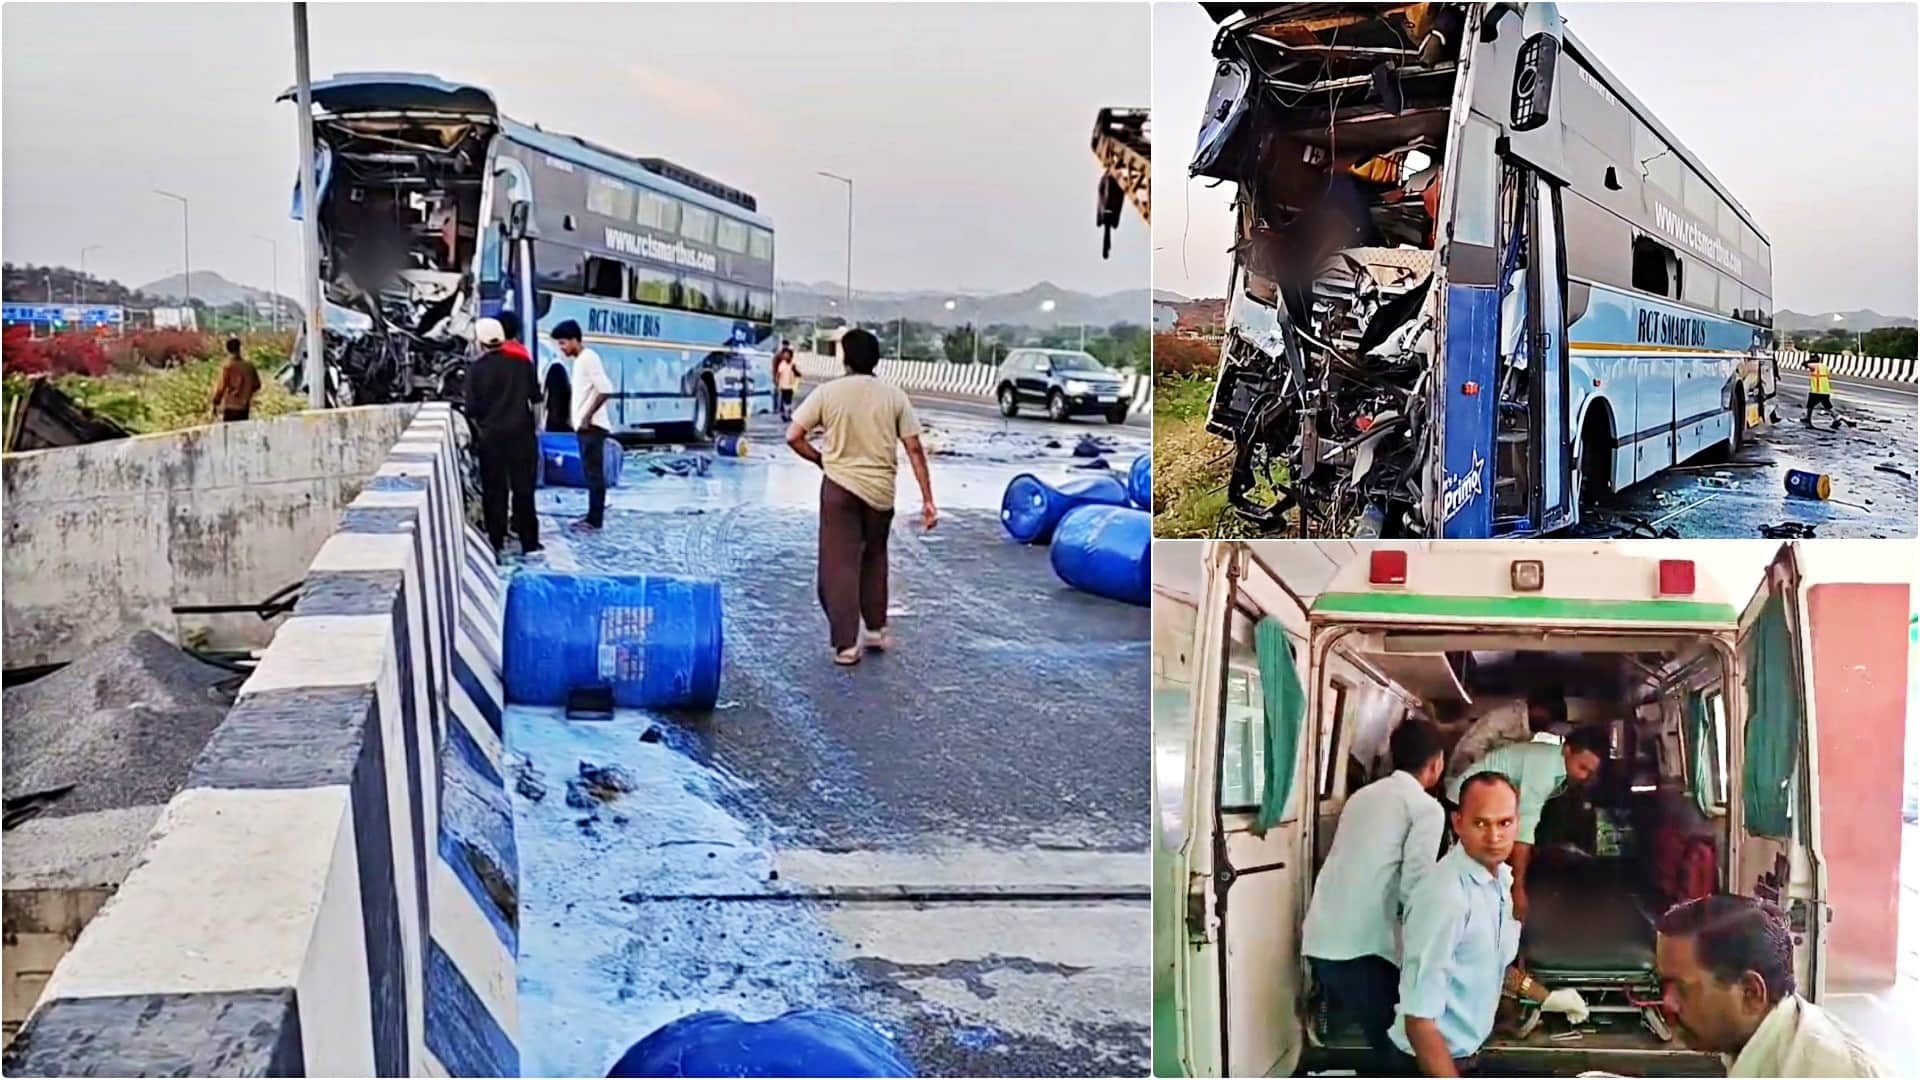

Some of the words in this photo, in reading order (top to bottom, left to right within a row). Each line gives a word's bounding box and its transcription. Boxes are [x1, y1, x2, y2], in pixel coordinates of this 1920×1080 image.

[605, 227, 716, 272] www.rctsmartbus.com
[1655, 200, 1742, 276] www.rctsmartbus.com
[588, 308, 608, 333] RCT
[610, 311, 641, 336] SMART
[643, 314, 661, 337] BUS
[1637, 308, 1660, 343] RCT
[1660, 313, 1691, 346] SMART
[1691, 319, 1706, 347] BUS
[1444, 470, 1478, 518] Primo
